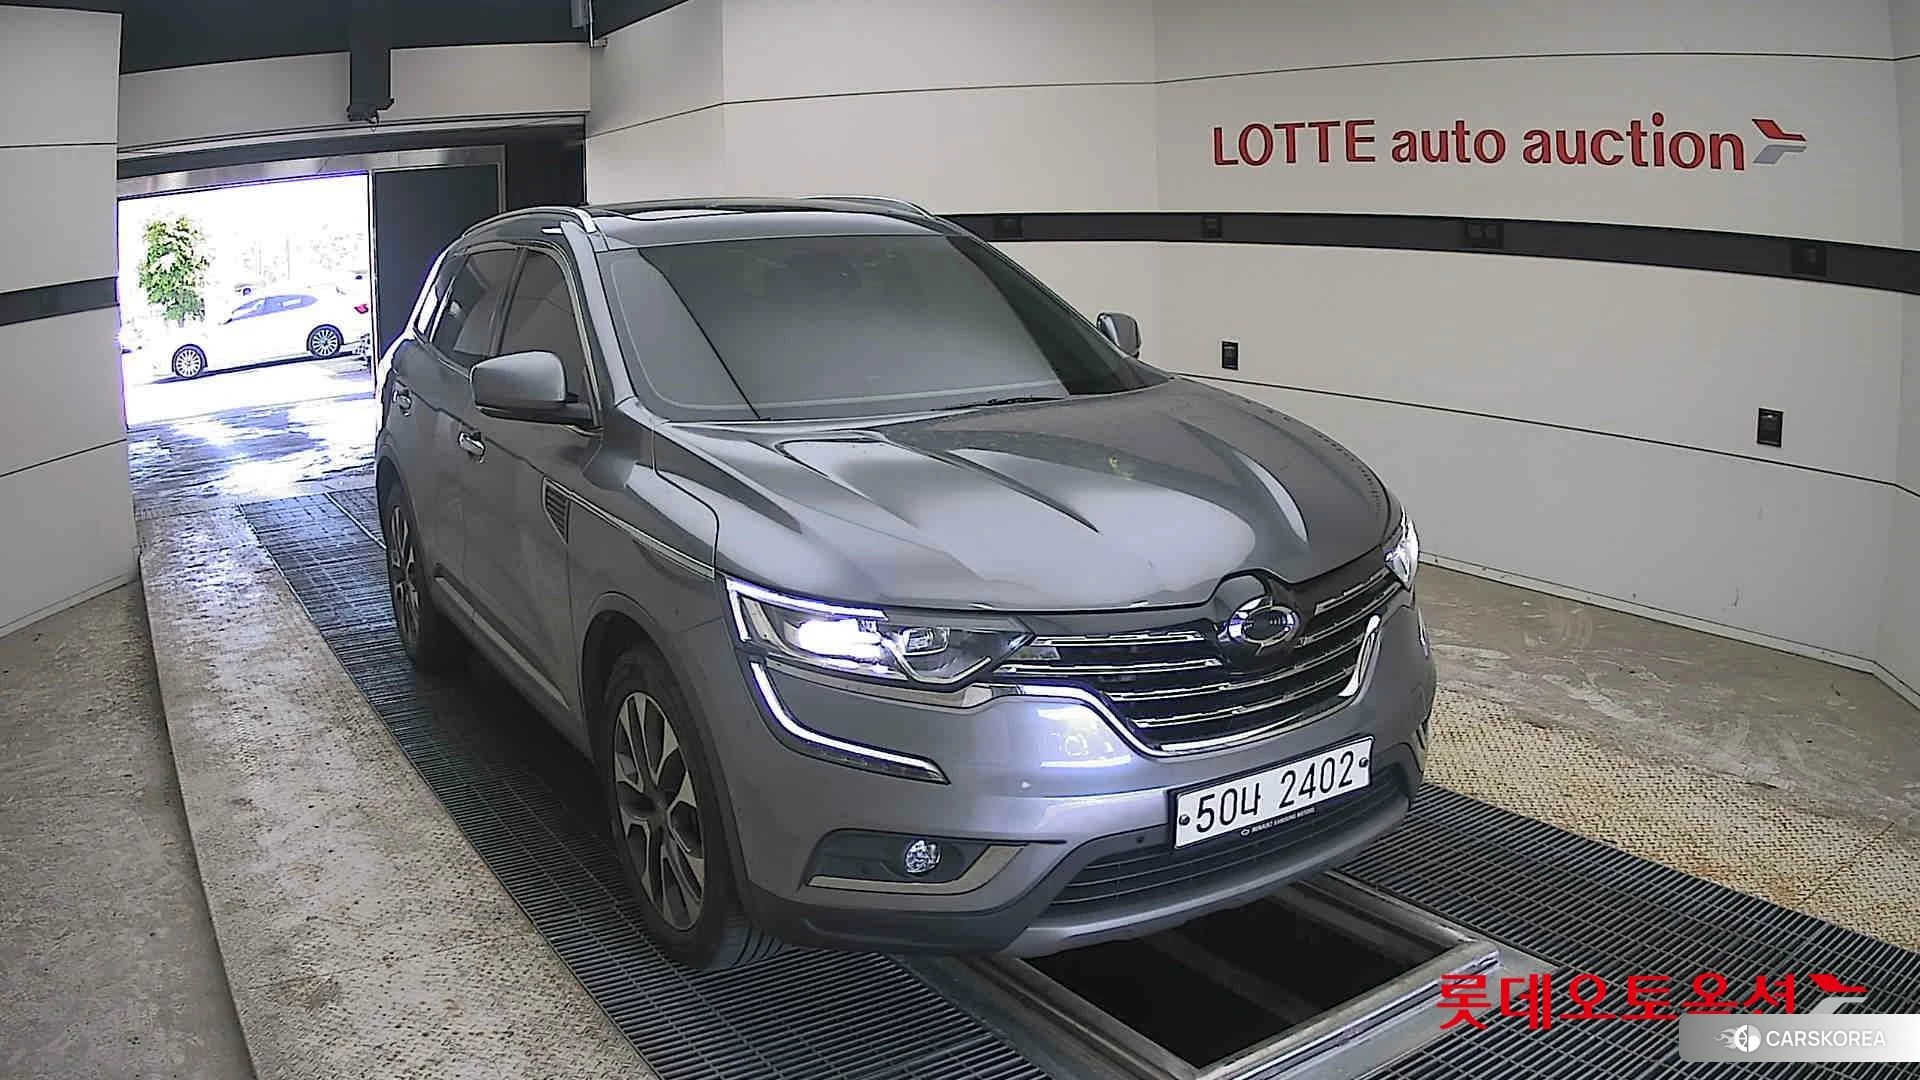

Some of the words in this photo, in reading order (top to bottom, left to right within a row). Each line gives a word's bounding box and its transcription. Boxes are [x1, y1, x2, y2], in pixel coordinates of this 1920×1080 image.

[1214, 119, 1376, 166] LOTTE
[1391, 119, 1506, 164] auto
[1522, 112, 1745, 171] auction
[1196, 782, 1262, 833] 50나
[1279, 750, 1354, 808] 2402
